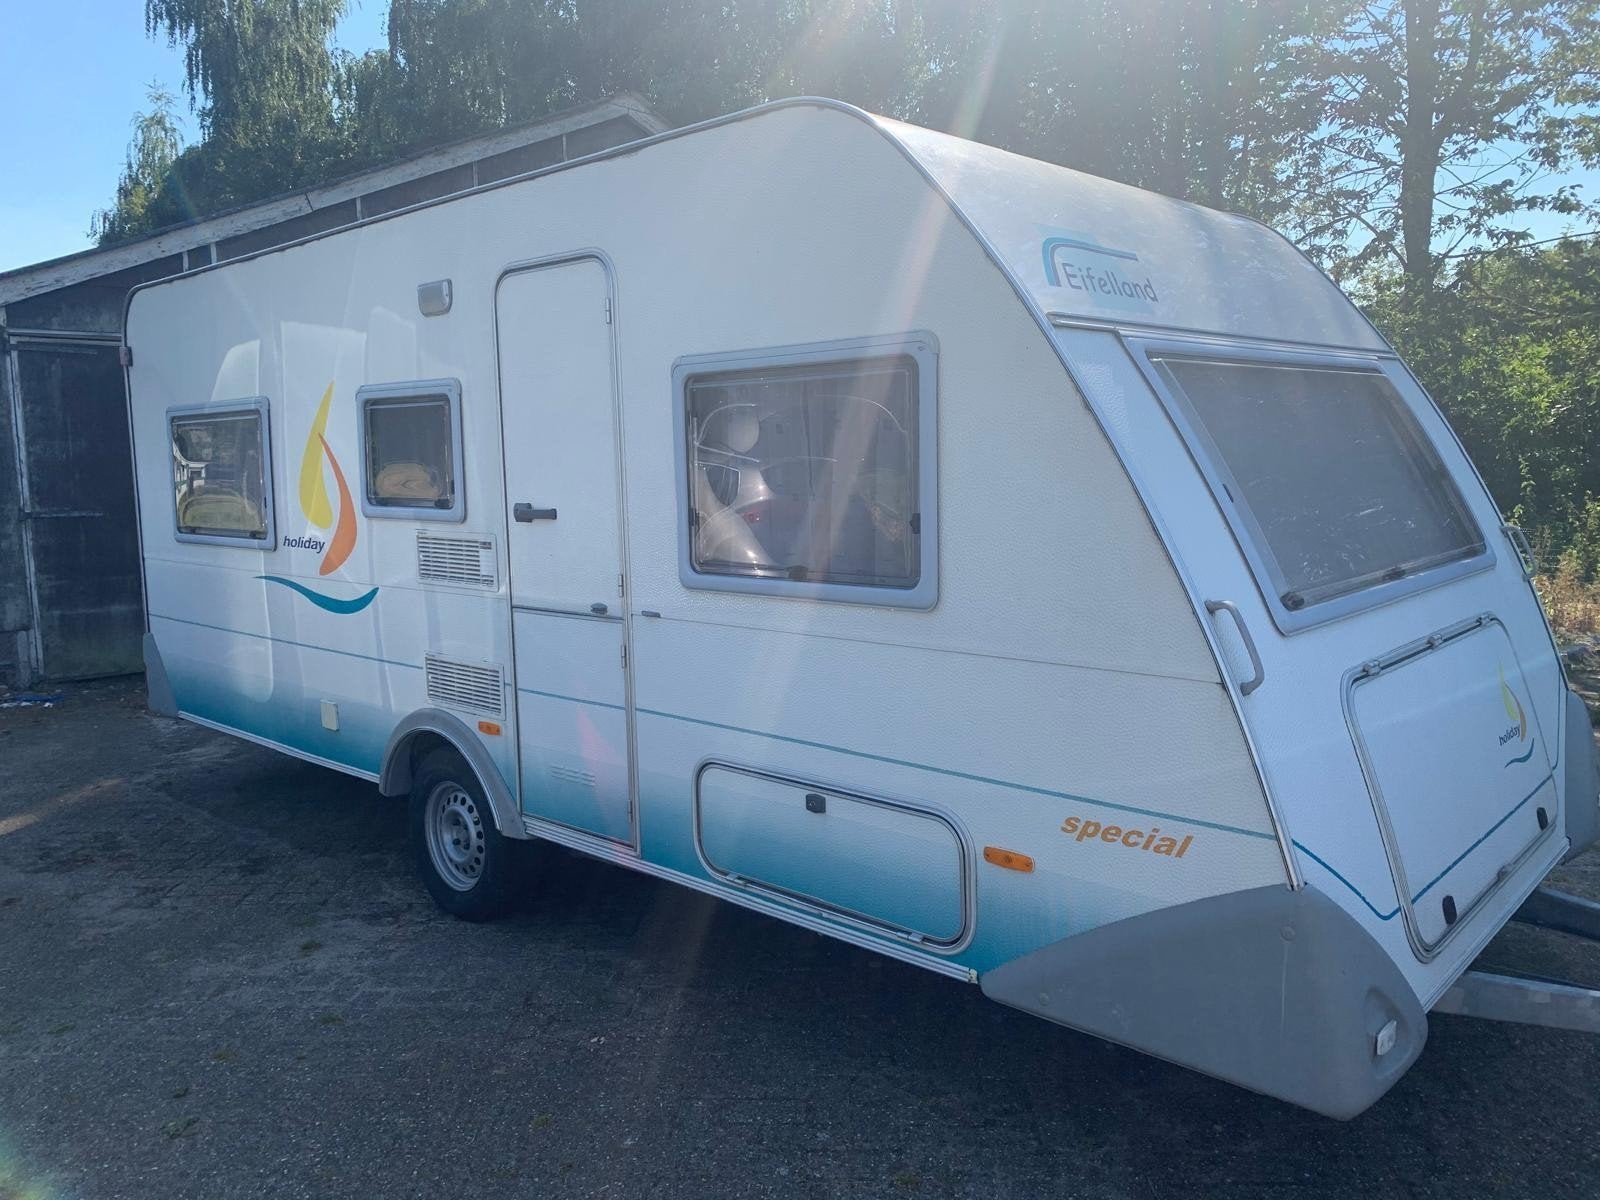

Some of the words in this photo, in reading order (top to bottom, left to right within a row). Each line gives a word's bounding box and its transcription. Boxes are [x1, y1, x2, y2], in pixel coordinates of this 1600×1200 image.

[1061, 262, 1160, 303] Eifelland
[283, 535, 325, 554] holiday
[1498, 724, 1521, 746] holiday
[1060, 816, 1194, 859] special
